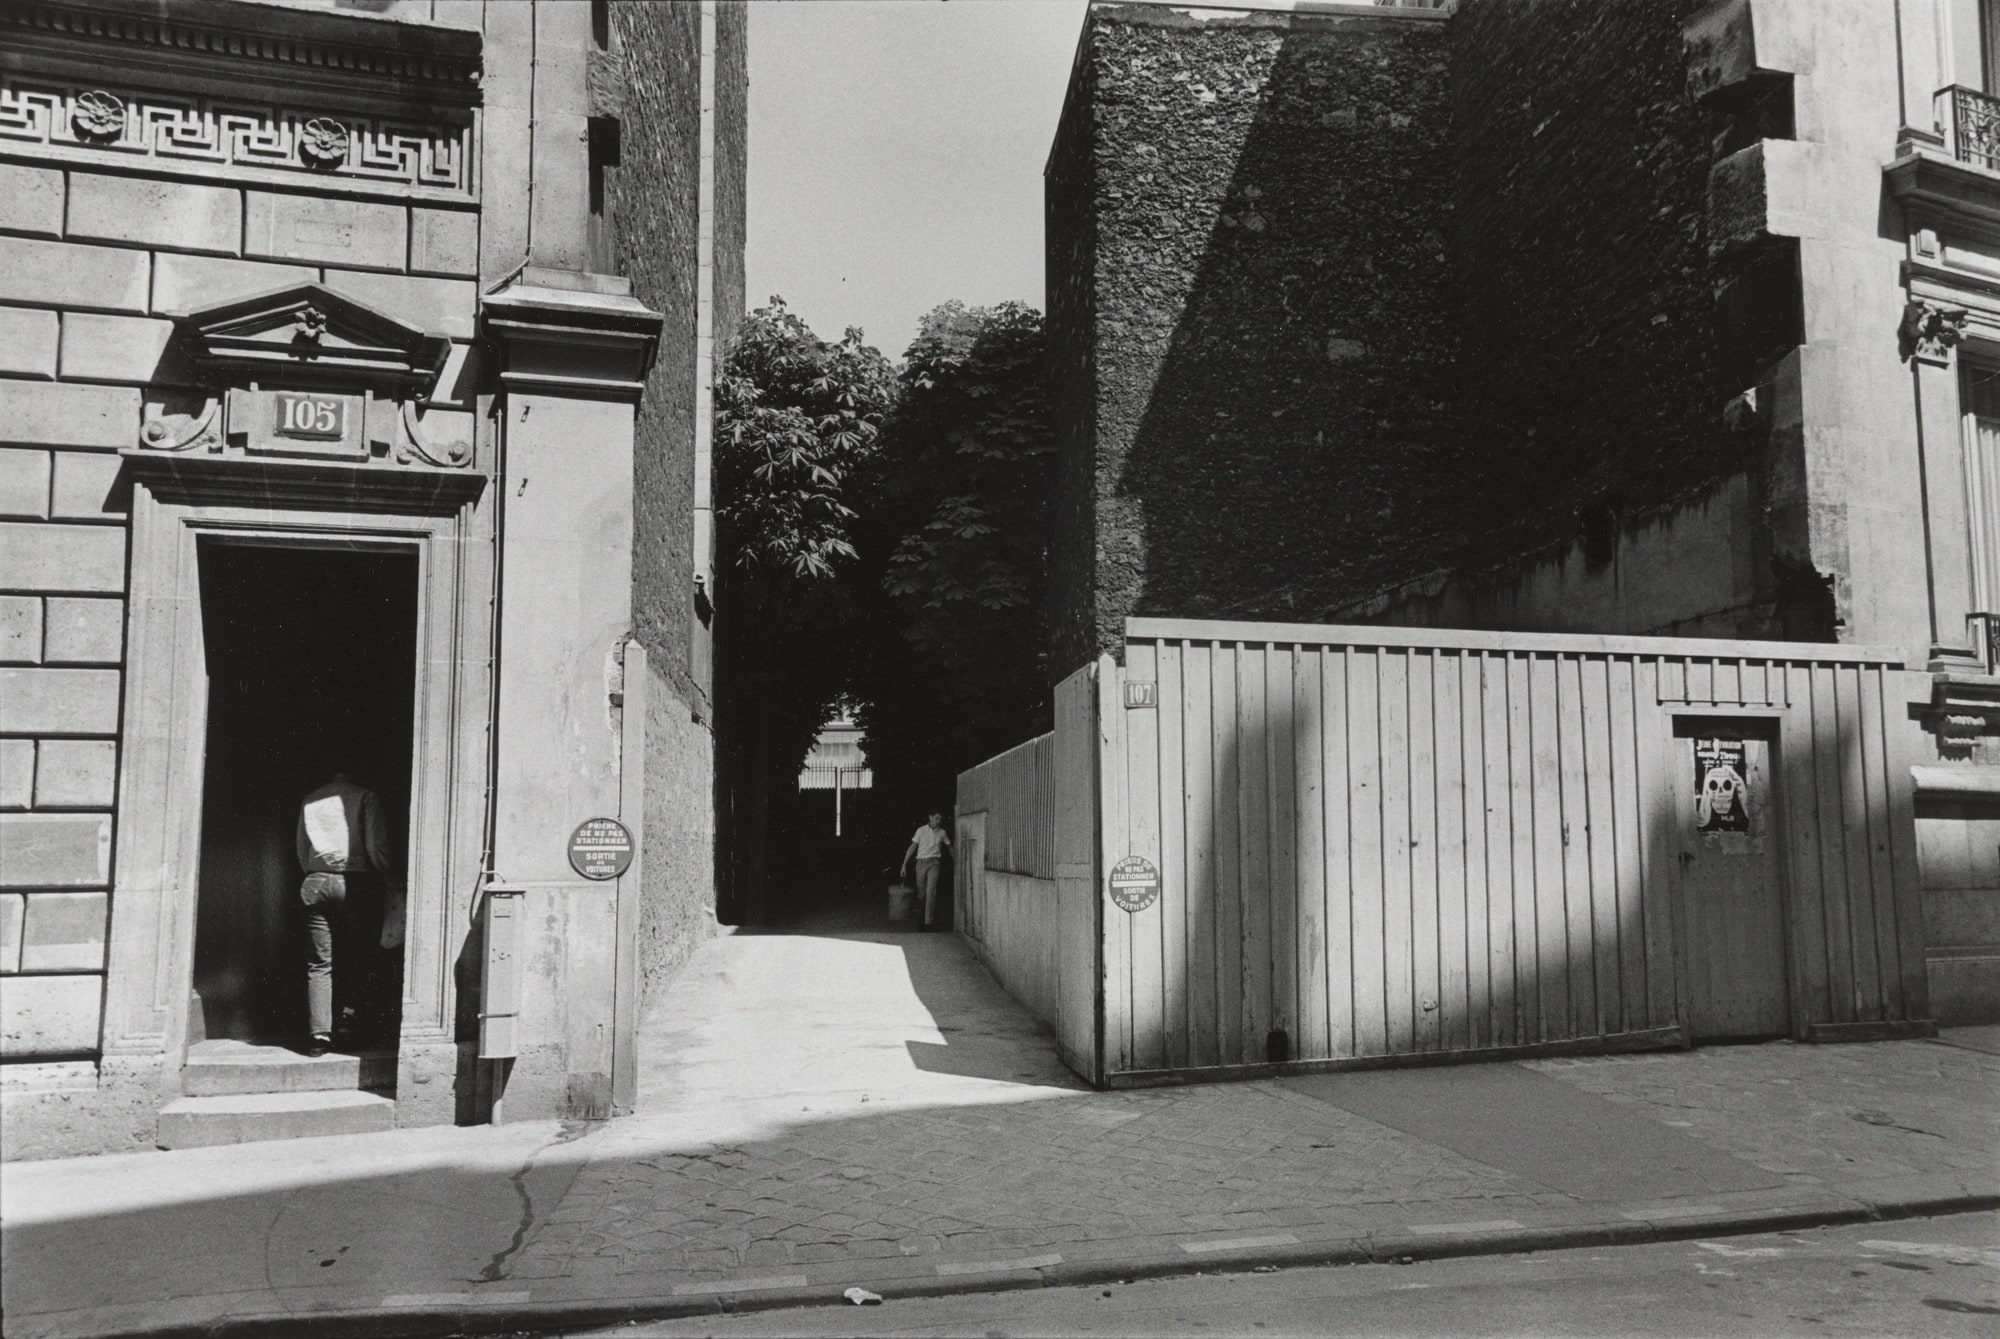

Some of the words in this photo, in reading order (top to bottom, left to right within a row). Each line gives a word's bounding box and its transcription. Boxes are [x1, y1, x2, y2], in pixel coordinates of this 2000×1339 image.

[283, 398, 337, 432] 105
[1128, 684, 1152, 704] 107
[585, 852, 616, 860] SORTIE
[585, 865, 615, 873] VOITURES
[1133, 865, 1144, 873] PAS
[1113, 873, 1154, 881] STATIONNER
[1115, 894, 1155, 910] VOITURES
[1130, 894, 1139, 902] DE
